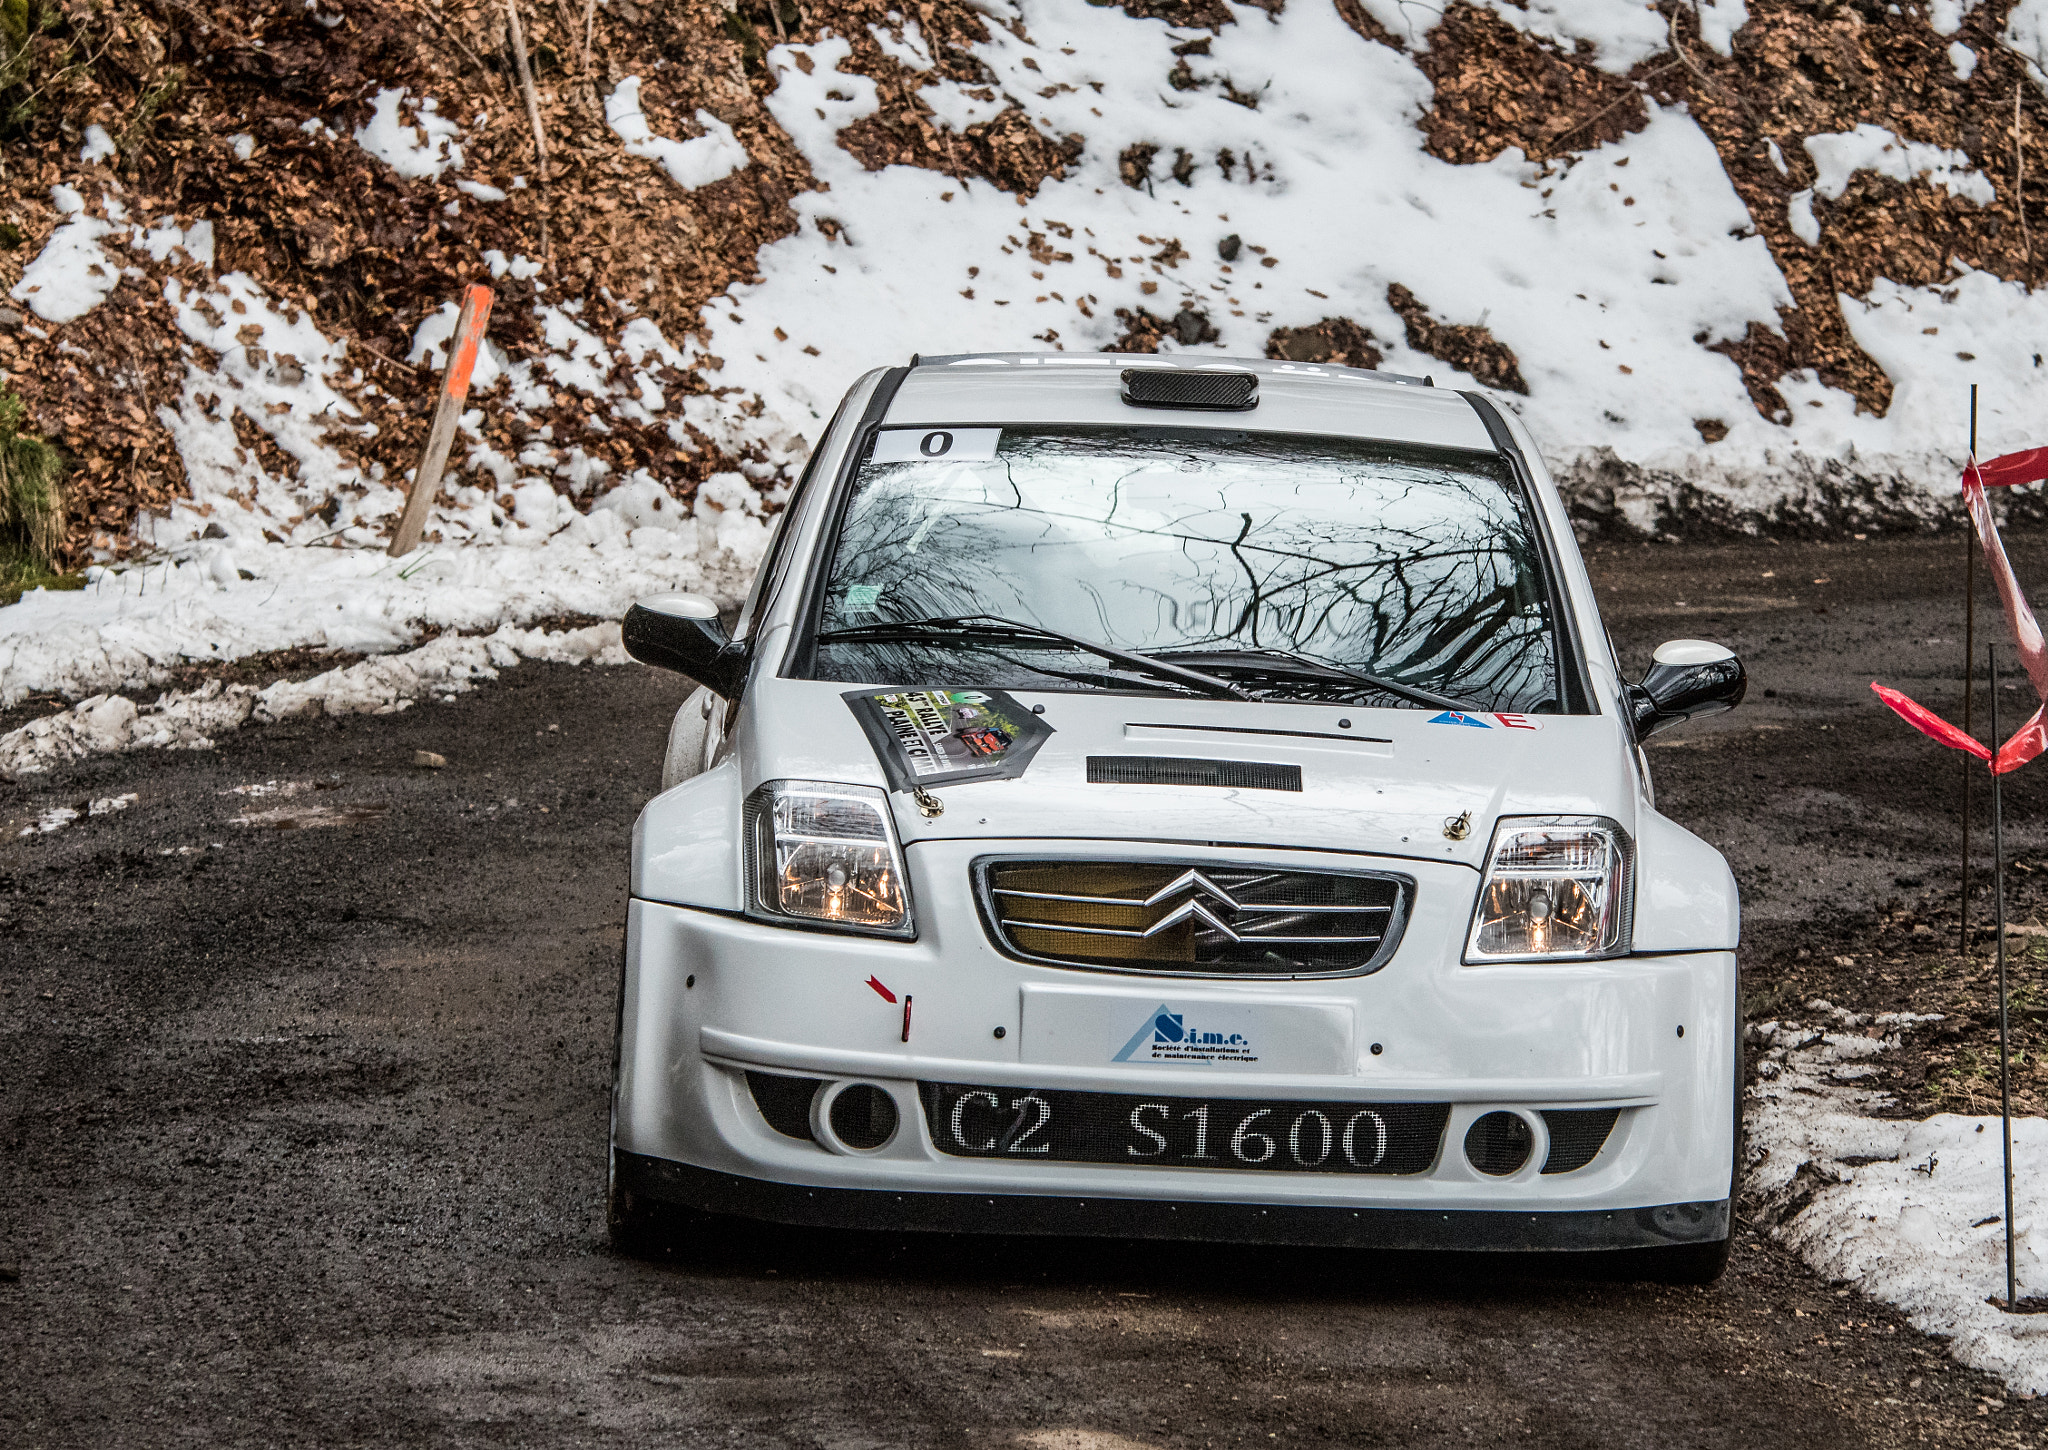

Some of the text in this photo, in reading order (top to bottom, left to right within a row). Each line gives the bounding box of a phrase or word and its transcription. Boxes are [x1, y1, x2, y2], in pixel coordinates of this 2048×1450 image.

[920, 431, 954, 457] 0
[885, 711, 918, 738] PLAINE
[903, 739, 924, 747] ET
[915, 708, 948, 735] RALLYE
[1493, 712, 1537, 730] E
[1164, 1052, 1215, 1060] maintenance
[1217, 1054, 1258, 1062] électrique
[1184, 1045, 1239, 1053] d'installations
[951, 1090, 1387, 1167] C2 S1600
